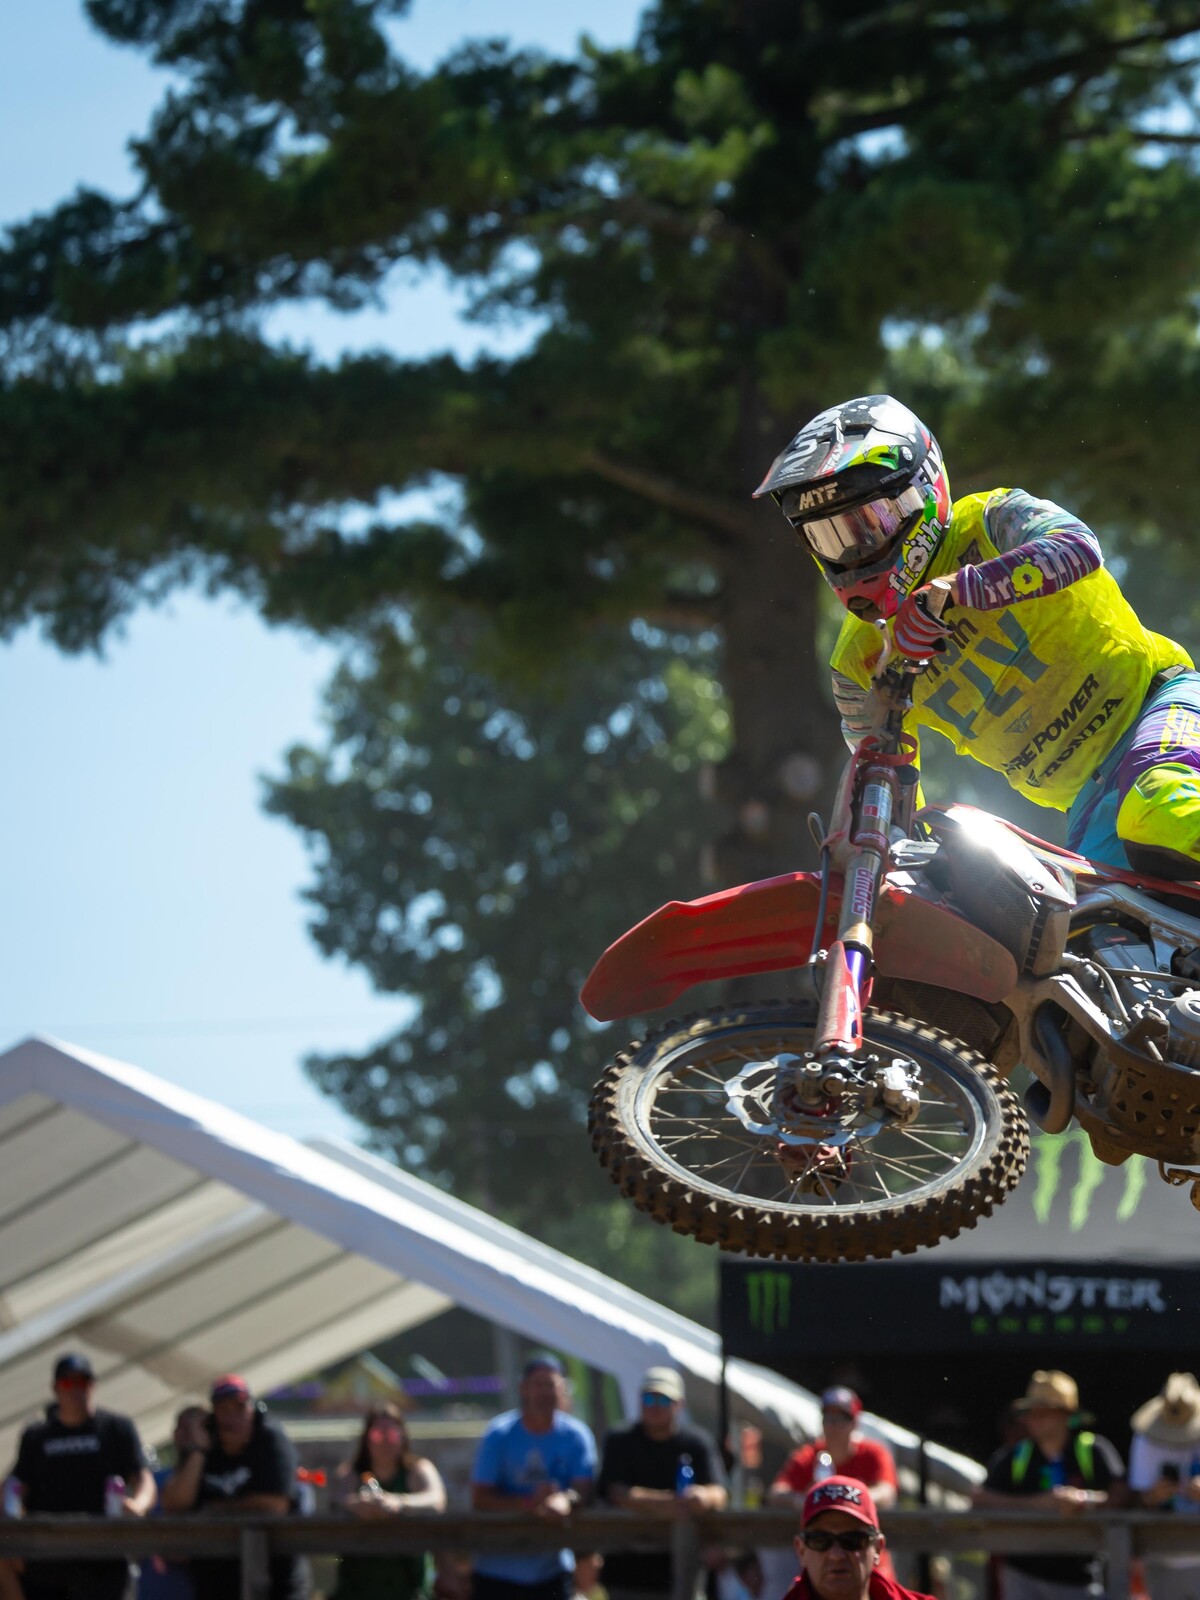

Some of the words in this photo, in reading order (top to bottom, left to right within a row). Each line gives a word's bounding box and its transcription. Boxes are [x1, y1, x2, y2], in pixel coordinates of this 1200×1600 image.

[799, 481, 839, 511] MTF
[889, 516, 943, 596] froth
[923, 609, 1050, 741] FLY
[1001, 743, 1038, 776] RE
[1032, 673, 1099, 753] POWER
[851, 867, 876, 921] SHOWA
[939, 1270, 1167, 1314] MONSTER
